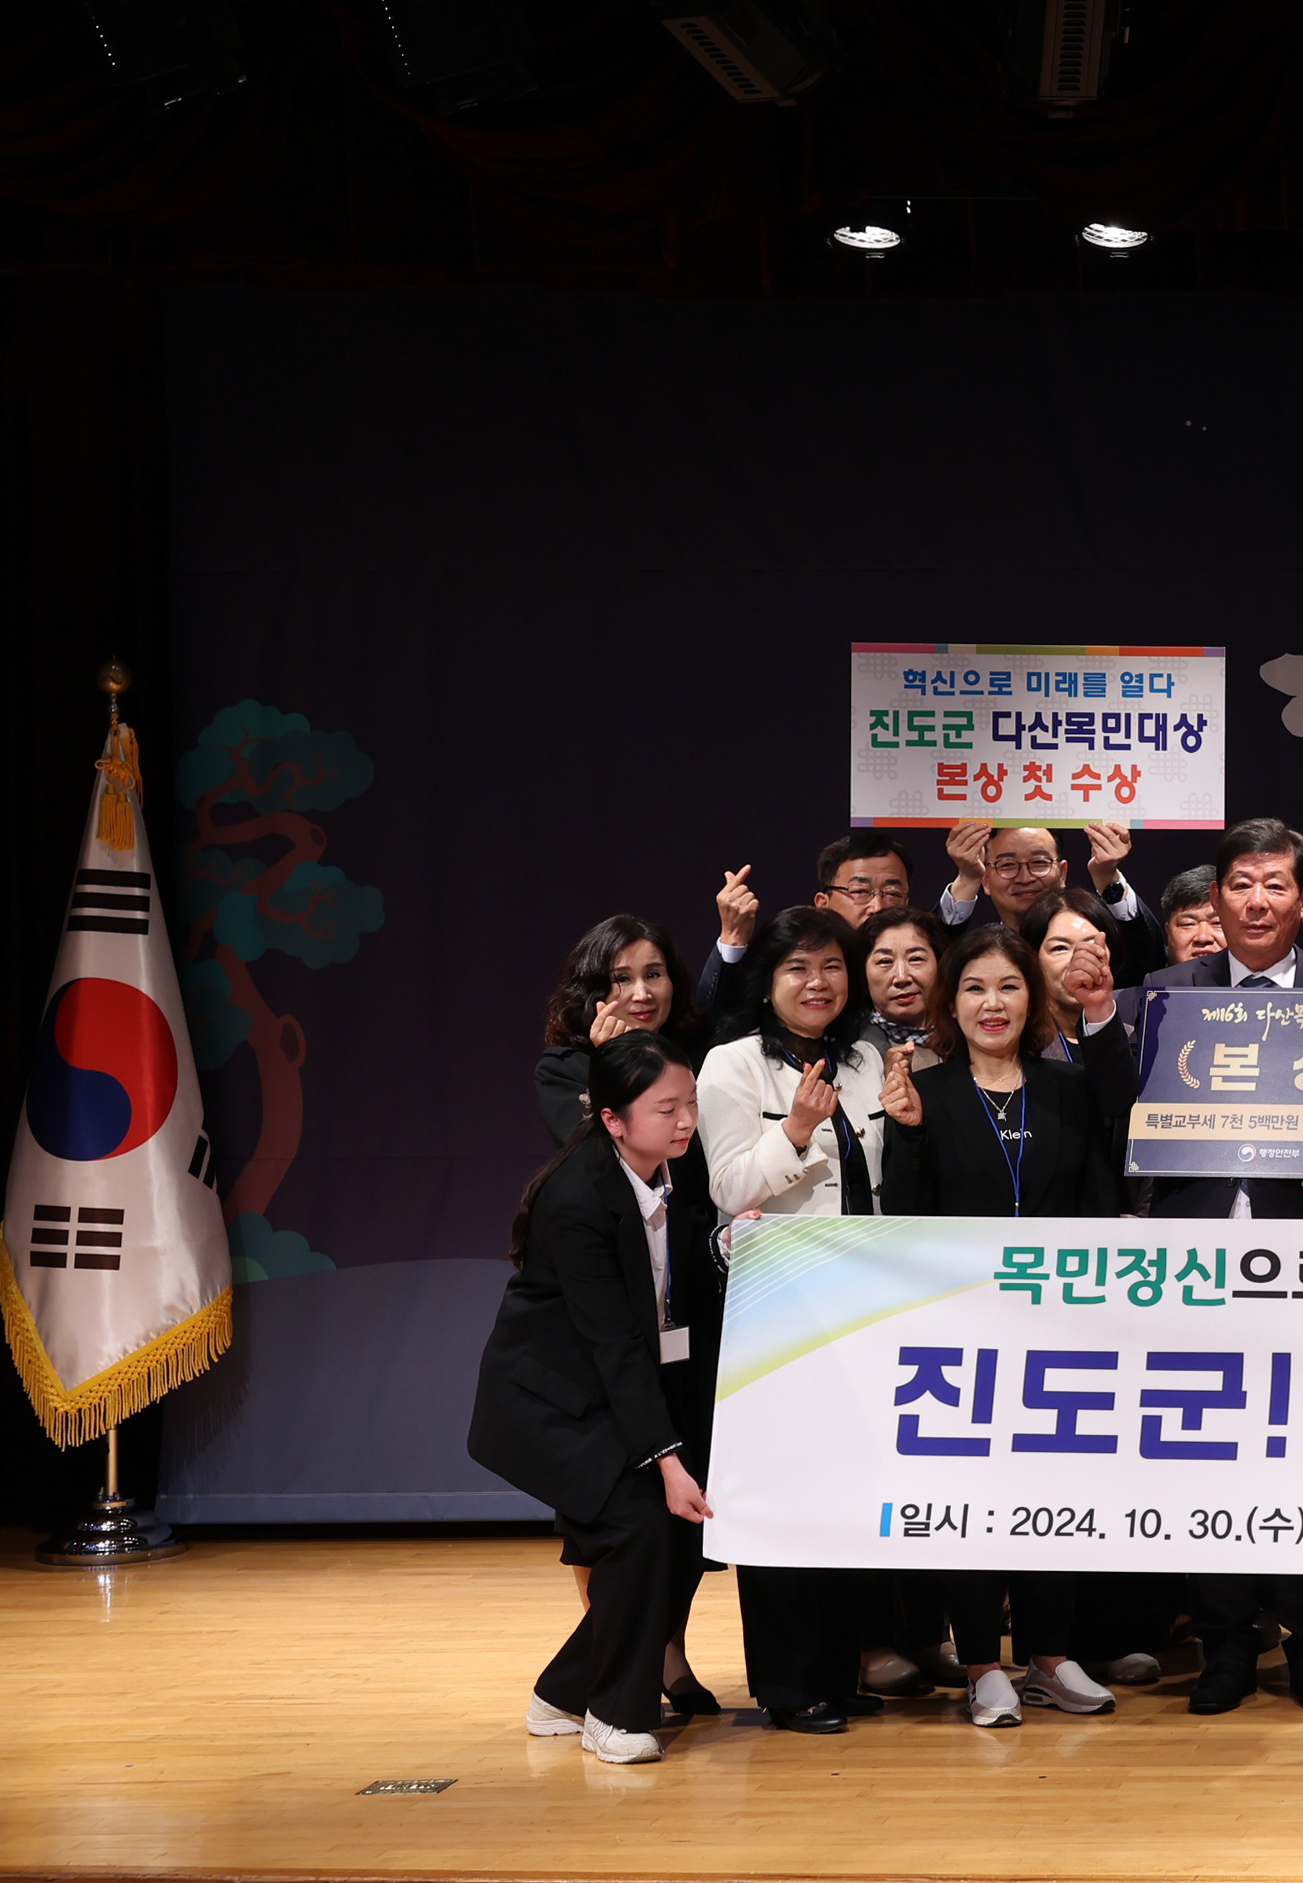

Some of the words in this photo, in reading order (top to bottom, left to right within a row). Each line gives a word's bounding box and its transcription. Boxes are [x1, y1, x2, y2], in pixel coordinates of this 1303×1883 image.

[903, 669, 1012, 695] 혁신으로
[1027, 672, 1106, 697] 미래를
[1120, 672, 1174, 698] 열다
[870, 710, 974, 749] 진도군
[991, 711, 1207, 753] 다산목민대상
[936, 762, 1007, 803] 본상
[1023, 761, 1052, 801] 첫
[1071, 764, 1141, 804] 수상
[1202, 1002, 1247, 1023] 제16회
[1000, 1128, 1033, 1141] Klen
[1145, 1114, 1215, 1129] 특별교부세
[1221, 1114, 1243, 1129] 7천
[1249, 1115, 1299, 1130] 5백만원
[1259, 1149, 1299, 1158] 행정안전부
[894, 1347, 1291, 1460] 진도군!
[901, 1503, 969, 1538] 일시
[1010, 1507, 1105, 1539] 2024.
[1125, 1509, 1171, 1540] 10.
